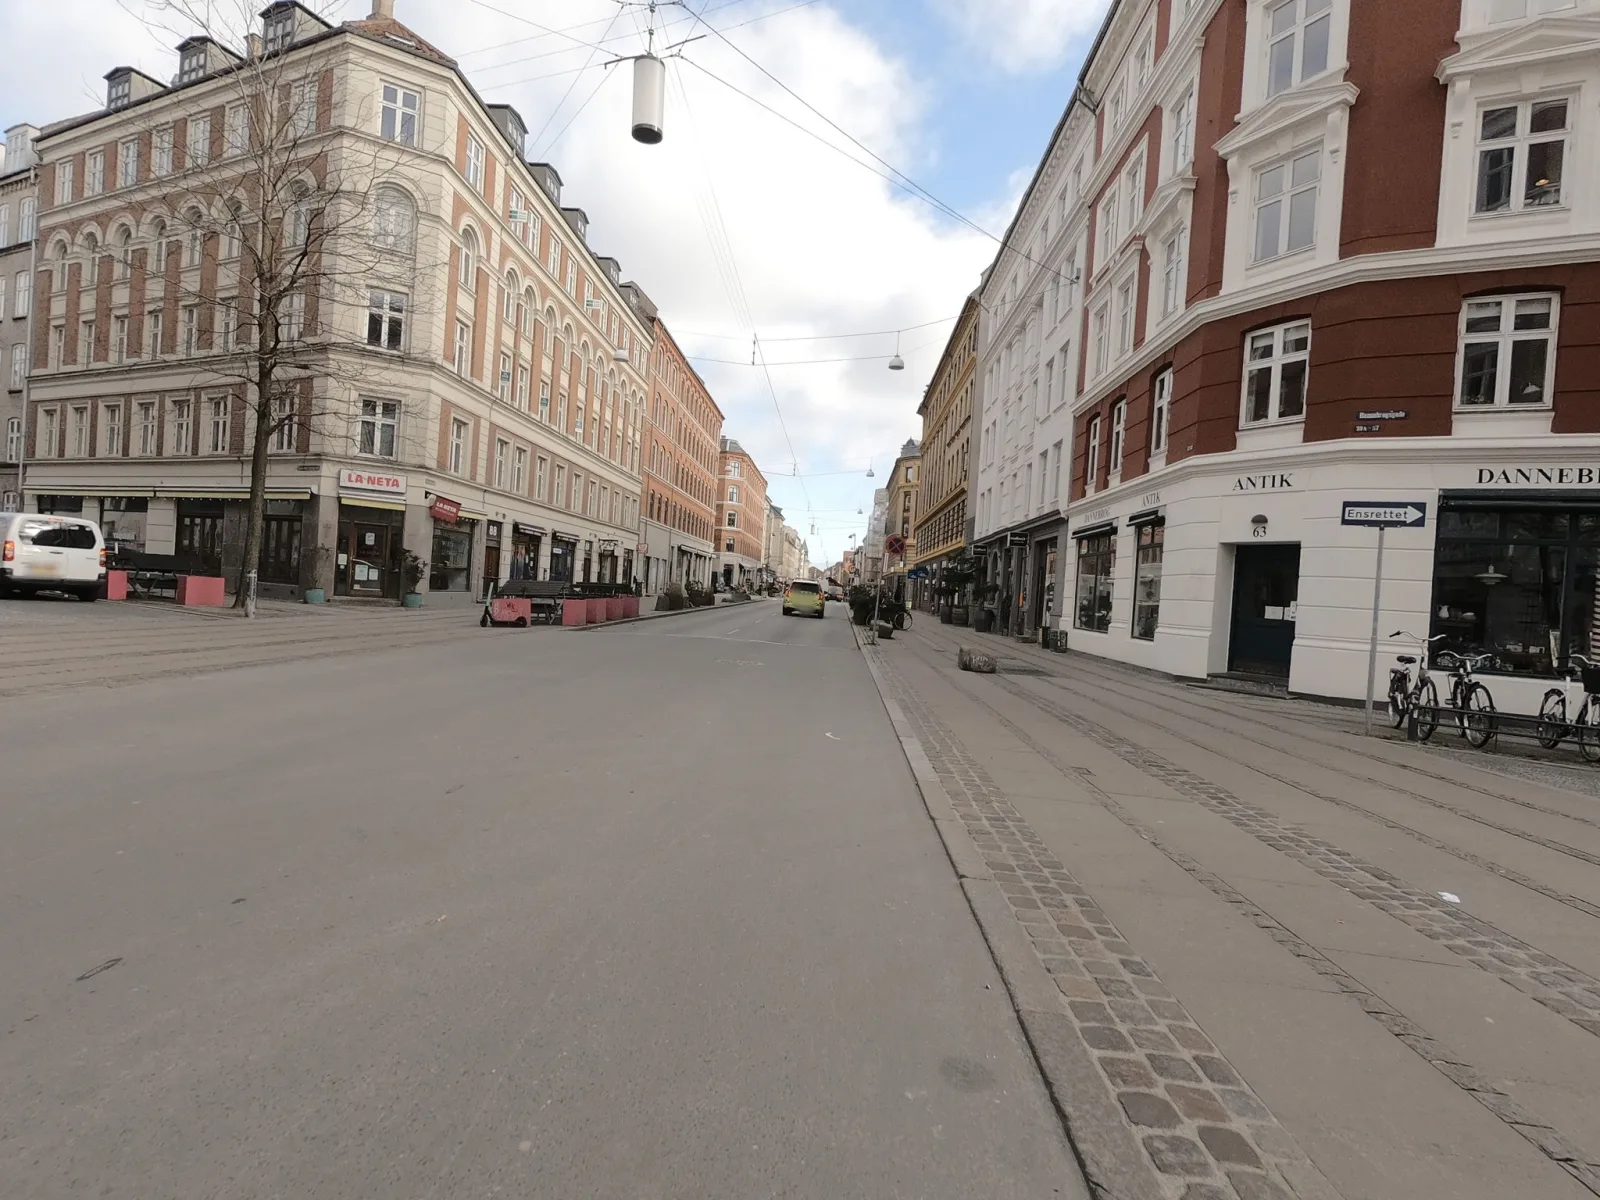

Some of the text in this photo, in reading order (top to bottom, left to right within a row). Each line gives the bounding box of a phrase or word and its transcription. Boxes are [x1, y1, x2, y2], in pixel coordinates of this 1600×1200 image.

[347, 473, 400, 488] LA NETA
[1232, 472, 1294, 491] ANTIK
[1477, 467, 1600, 485] DANNEB
[1141, 491, 1161, 507] ANTIK
[1347, 508, 1409, 520] Ensrettet
[1251, 525, 1268, 538] 63
